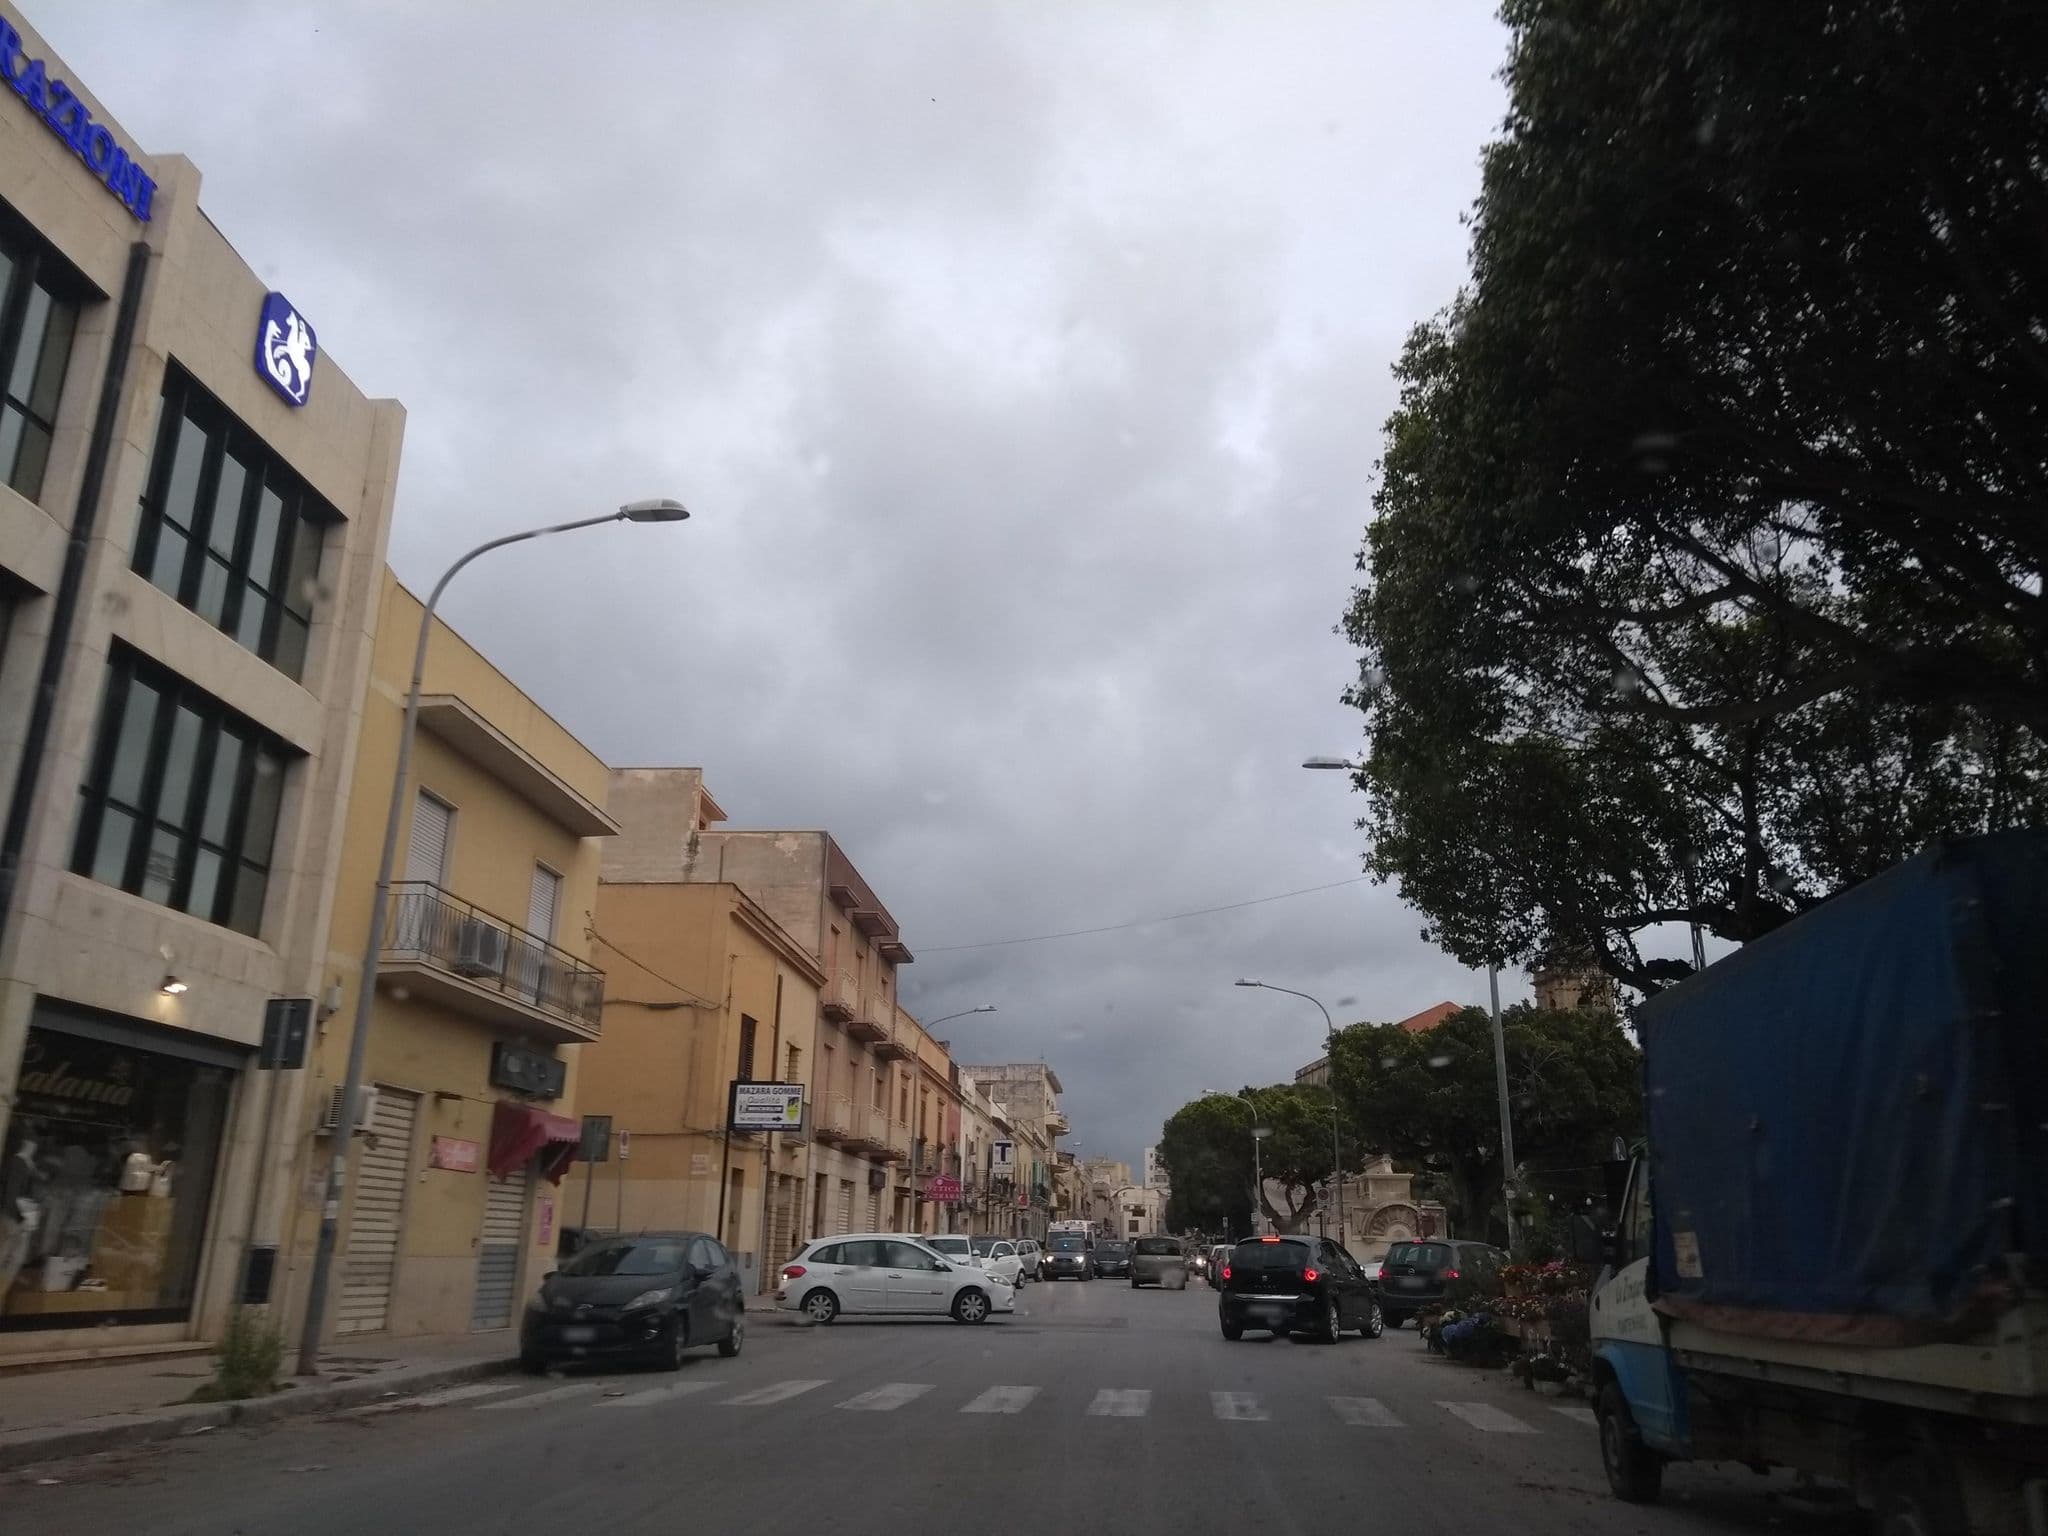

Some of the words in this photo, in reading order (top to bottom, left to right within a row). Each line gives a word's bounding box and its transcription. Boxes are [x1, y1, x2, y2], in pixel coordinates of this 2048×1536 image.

[739, 1087, 770, 1095] MAZARA
[772, 1087, 801, 1095] GOMME
[995, 1142, 1012, 1161] T
